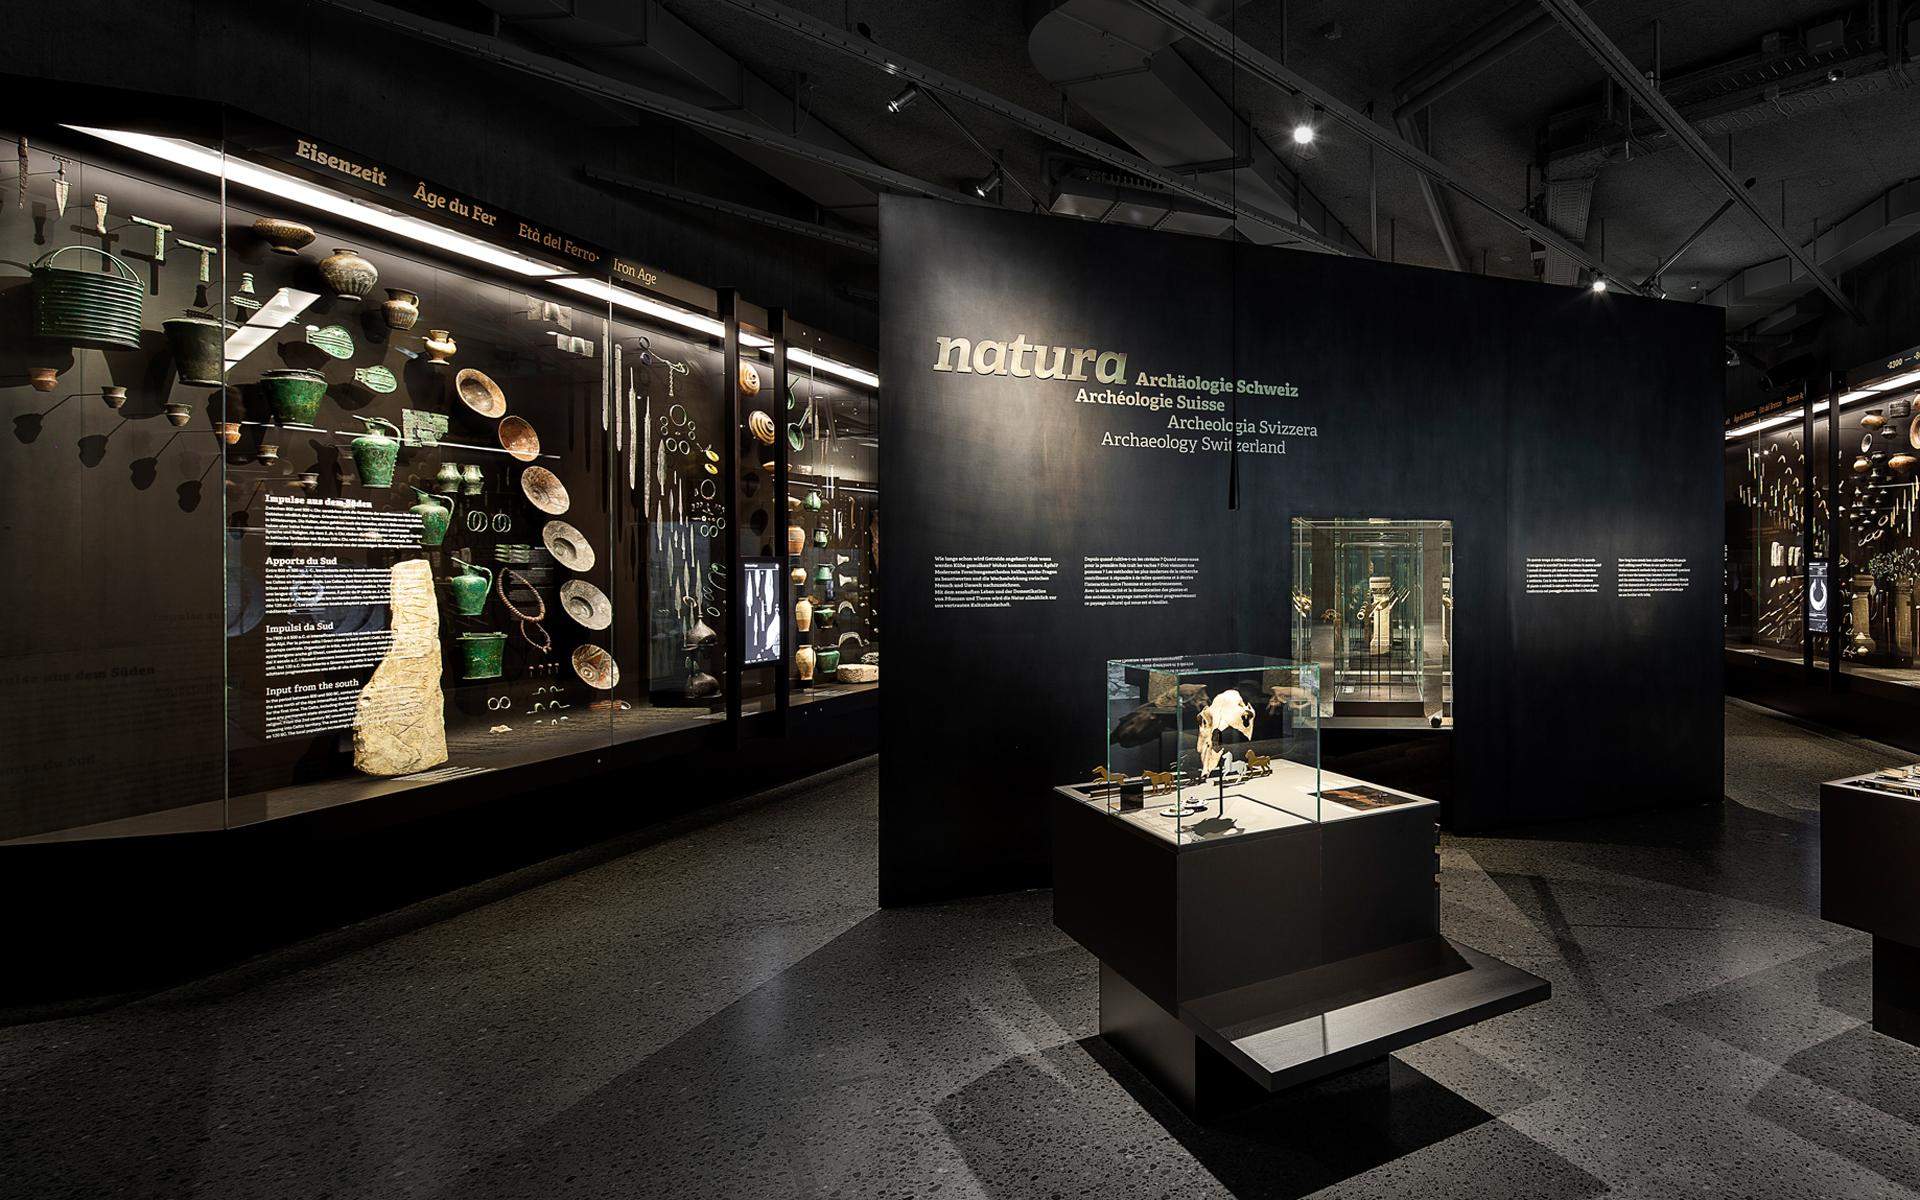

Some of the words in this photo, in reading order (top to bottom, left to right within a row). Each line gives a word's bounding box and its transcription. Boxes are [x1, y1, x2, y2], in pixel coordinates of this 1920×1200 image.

[296, 140, 387, 186] Eisenzeit
[414, 182, 446, 210] Âge
[449, 197, 468, 216] du
[472, 206, 497, 227] Fer
[518, 222, 540, 243] Età
[543, 232, 561, 251] del
[564, 240, 596, 262] Ferro
[613, 258, 635, 278] Iron
[637, 268, 657, 286] Age
[932, 333, 1128, 386] natura
[1136, 372, 1233, 394] Archäologie
[1236, 380, 1299, 398] Schweiz
[1076, 388, 1172, 411] Archéologie
[1177, 395, 1225, 412] Suisse
[1168, 415, 1256, 437] Archeologia
[1260, 420, 1318, 437] Svizzera
[1102, 432, 1197, 454] Archaeology
[1202, 436, 1286, 455] Switzerland
[265, 494, 305, 505] Impulse
[265, 556, 304, 566] Apports
[266, 623, 302, 634] Impulsi
[304, 622, 316, 631] da
[316, 622, 334, 630] Sud
[266, 686, 292, 696] Input
[294, 684, 316, 692] from
[318, 682, 333, 690] the
[335, 678, 359, 688] south
